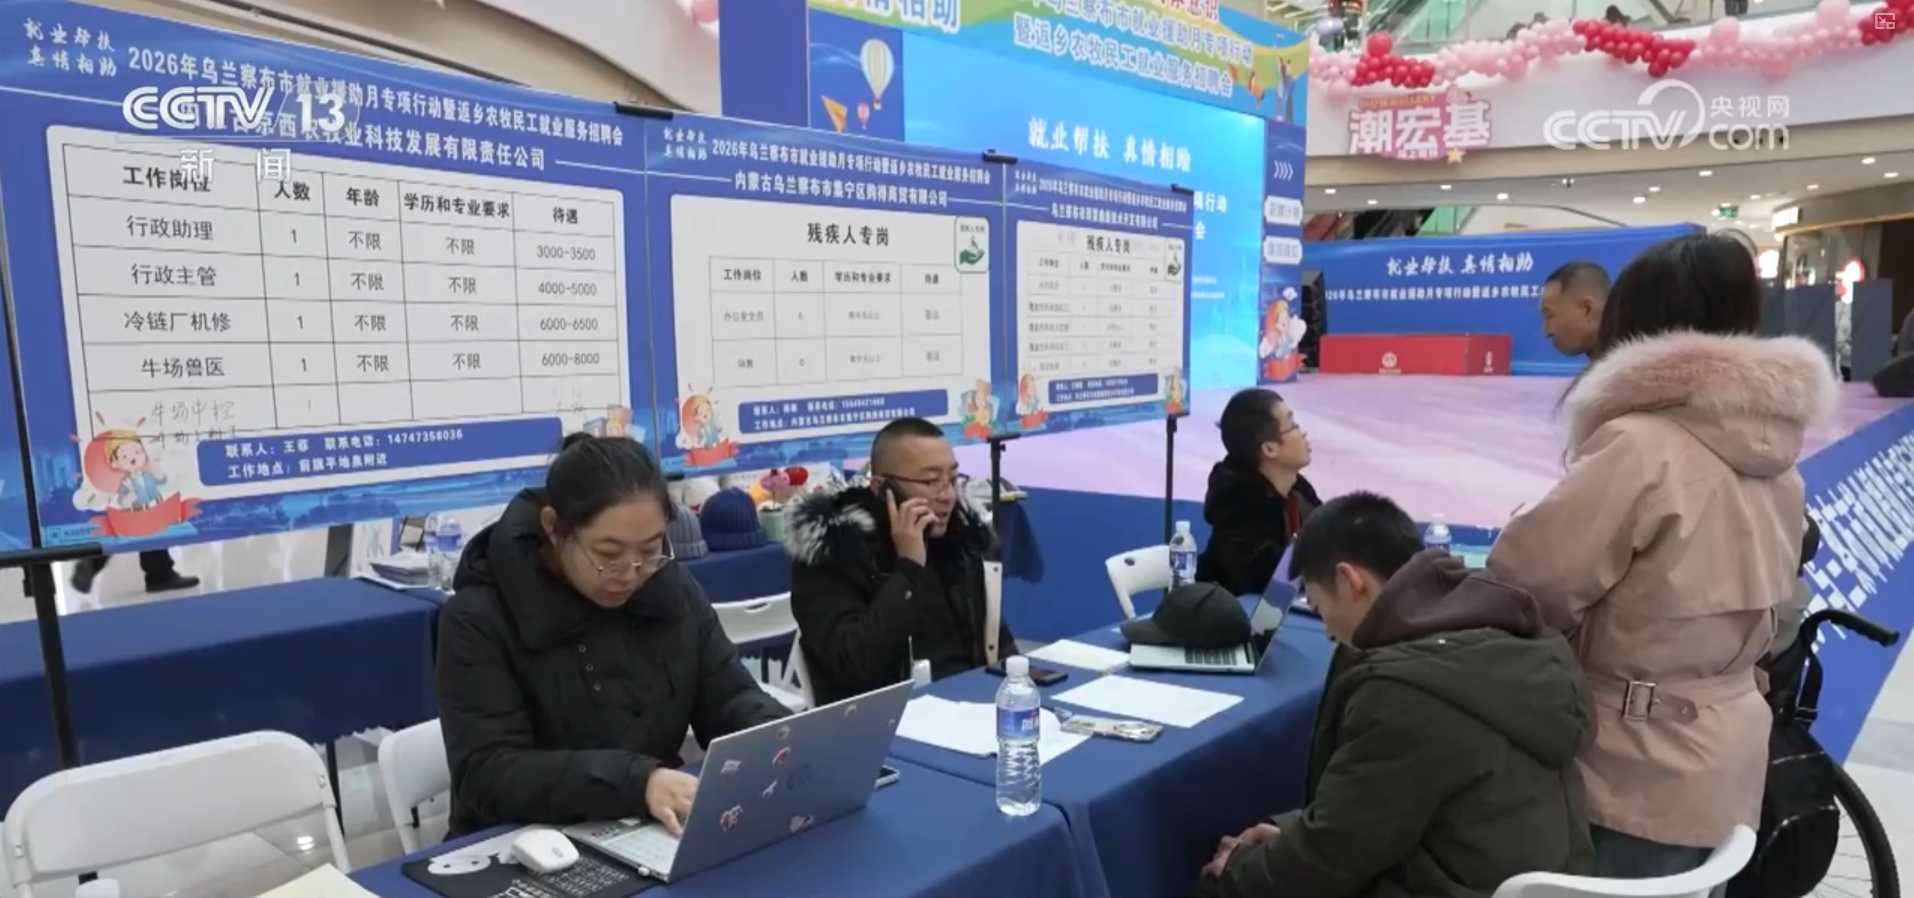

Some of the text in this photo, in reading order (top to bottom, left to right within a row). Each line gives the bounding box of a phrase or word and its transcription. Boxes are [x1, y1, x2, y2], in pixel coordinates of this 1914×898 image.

[24, 17, 115, 51] 就业帮扶
[27, 45, 117, 77] 真情相助
[1028, 117, 1110, 160] 就业帮扶
[1349, 102, 1491, 154] 潮宏基
[123, 166, 578, 225] 工作岗位 人数 年龄 学历和专业要求 待遇
[128, 215, 597, 261] 行政助理 1 不限 不限 3000-3500
[808, 223, 889, 246] 残疾人专岗
[131, 262, 598, 297] 行政主管 1 不限 不限 4000-5000
[124, 311, 599, 333] 冷链厂机修 1 不限 不限 6000-6500
[140, 353, 601, 379] 牛场兽医 1 不限 不限 6000-8000
